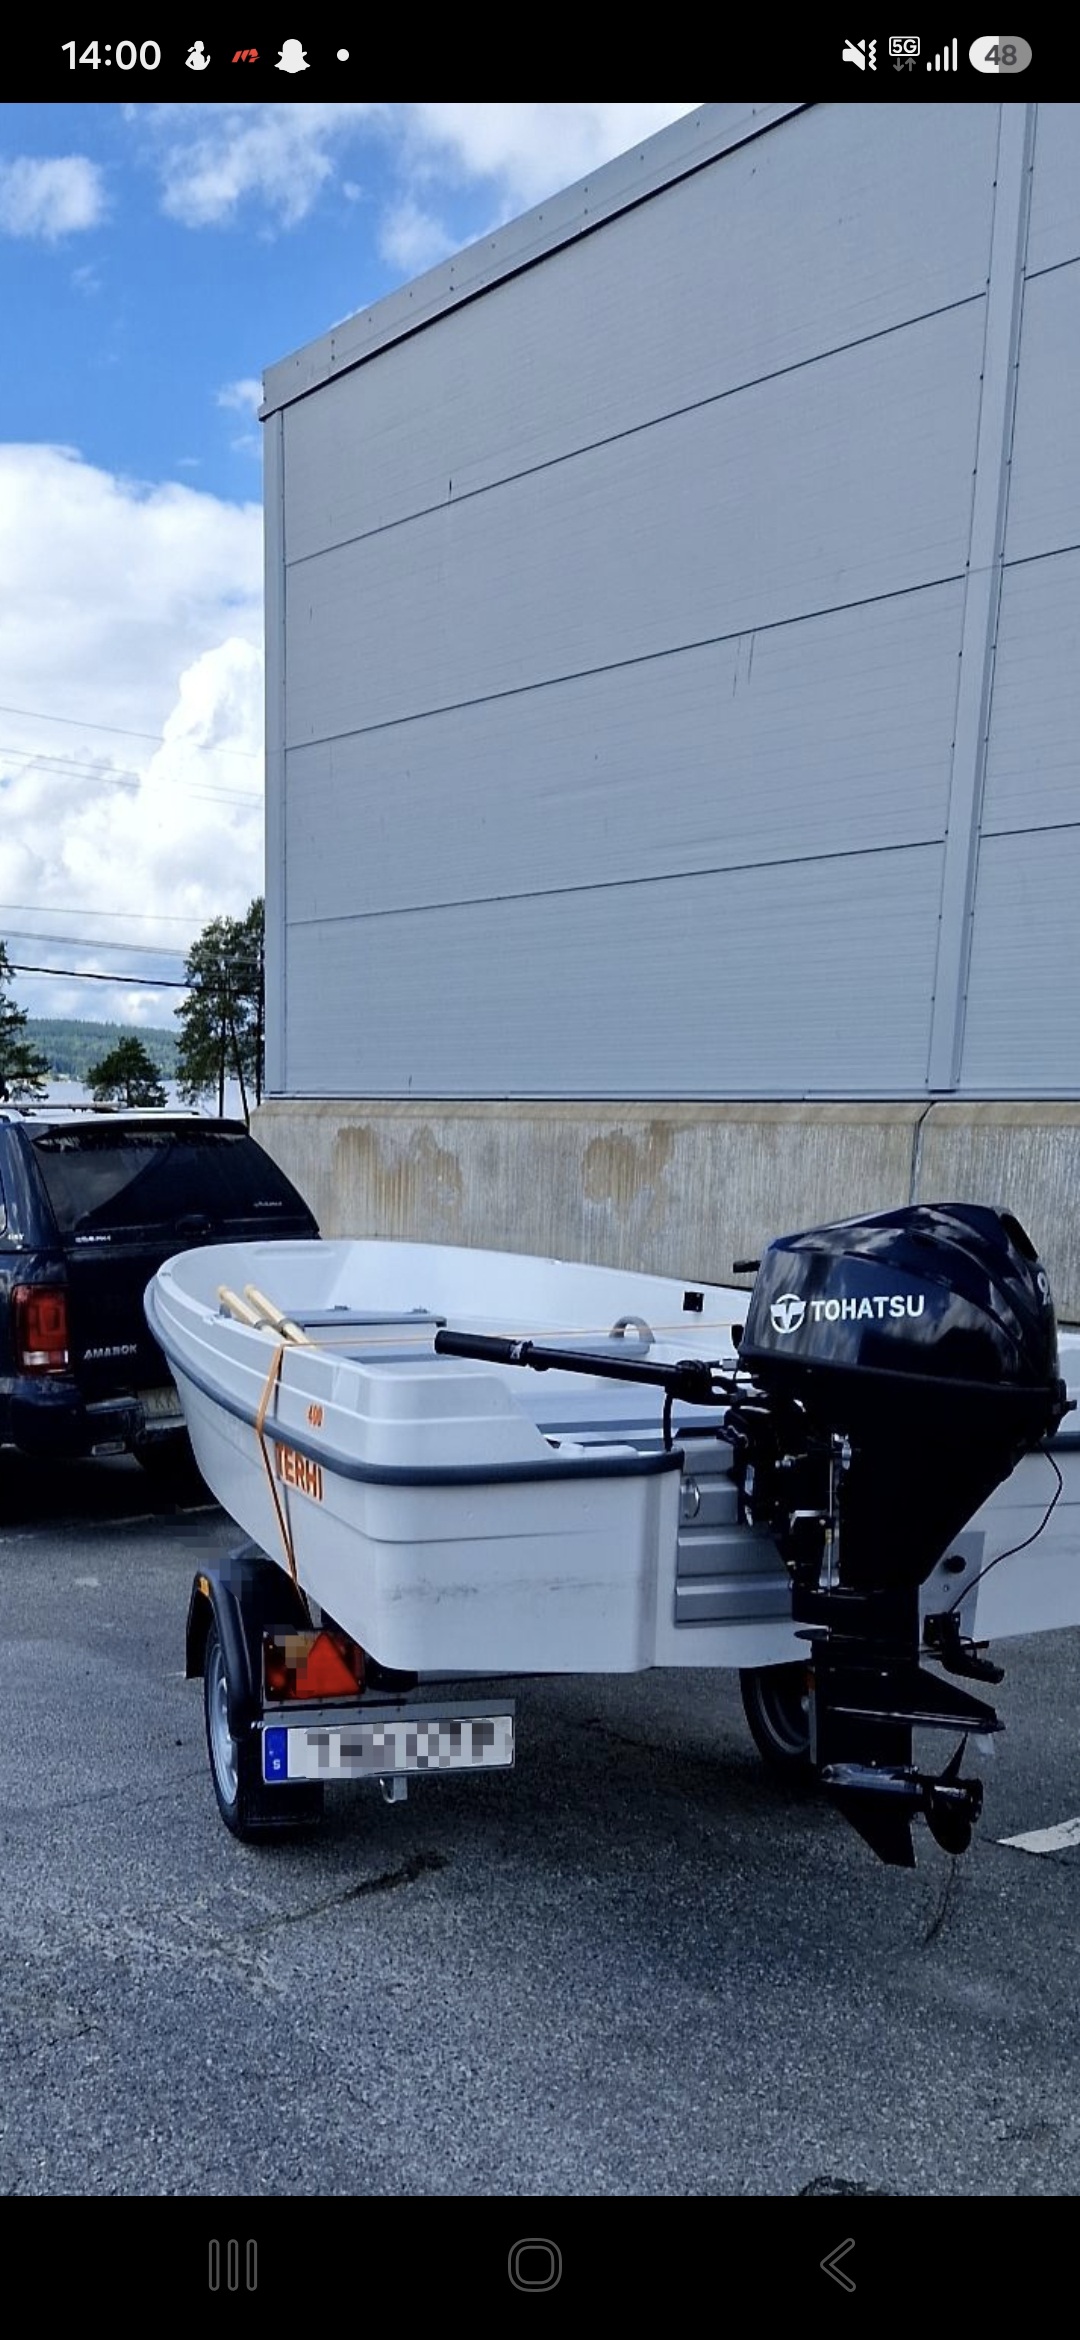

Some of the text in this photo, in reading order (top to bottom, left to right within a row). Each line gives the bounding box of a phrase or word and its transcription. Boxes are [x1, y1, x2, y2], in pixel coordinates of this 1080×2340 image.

[810, 1294, 925, 1322] TOHATSU
[83, 1343, 138, 1361] AMAROK
[275, 1441, 323, 1502] TERHI
